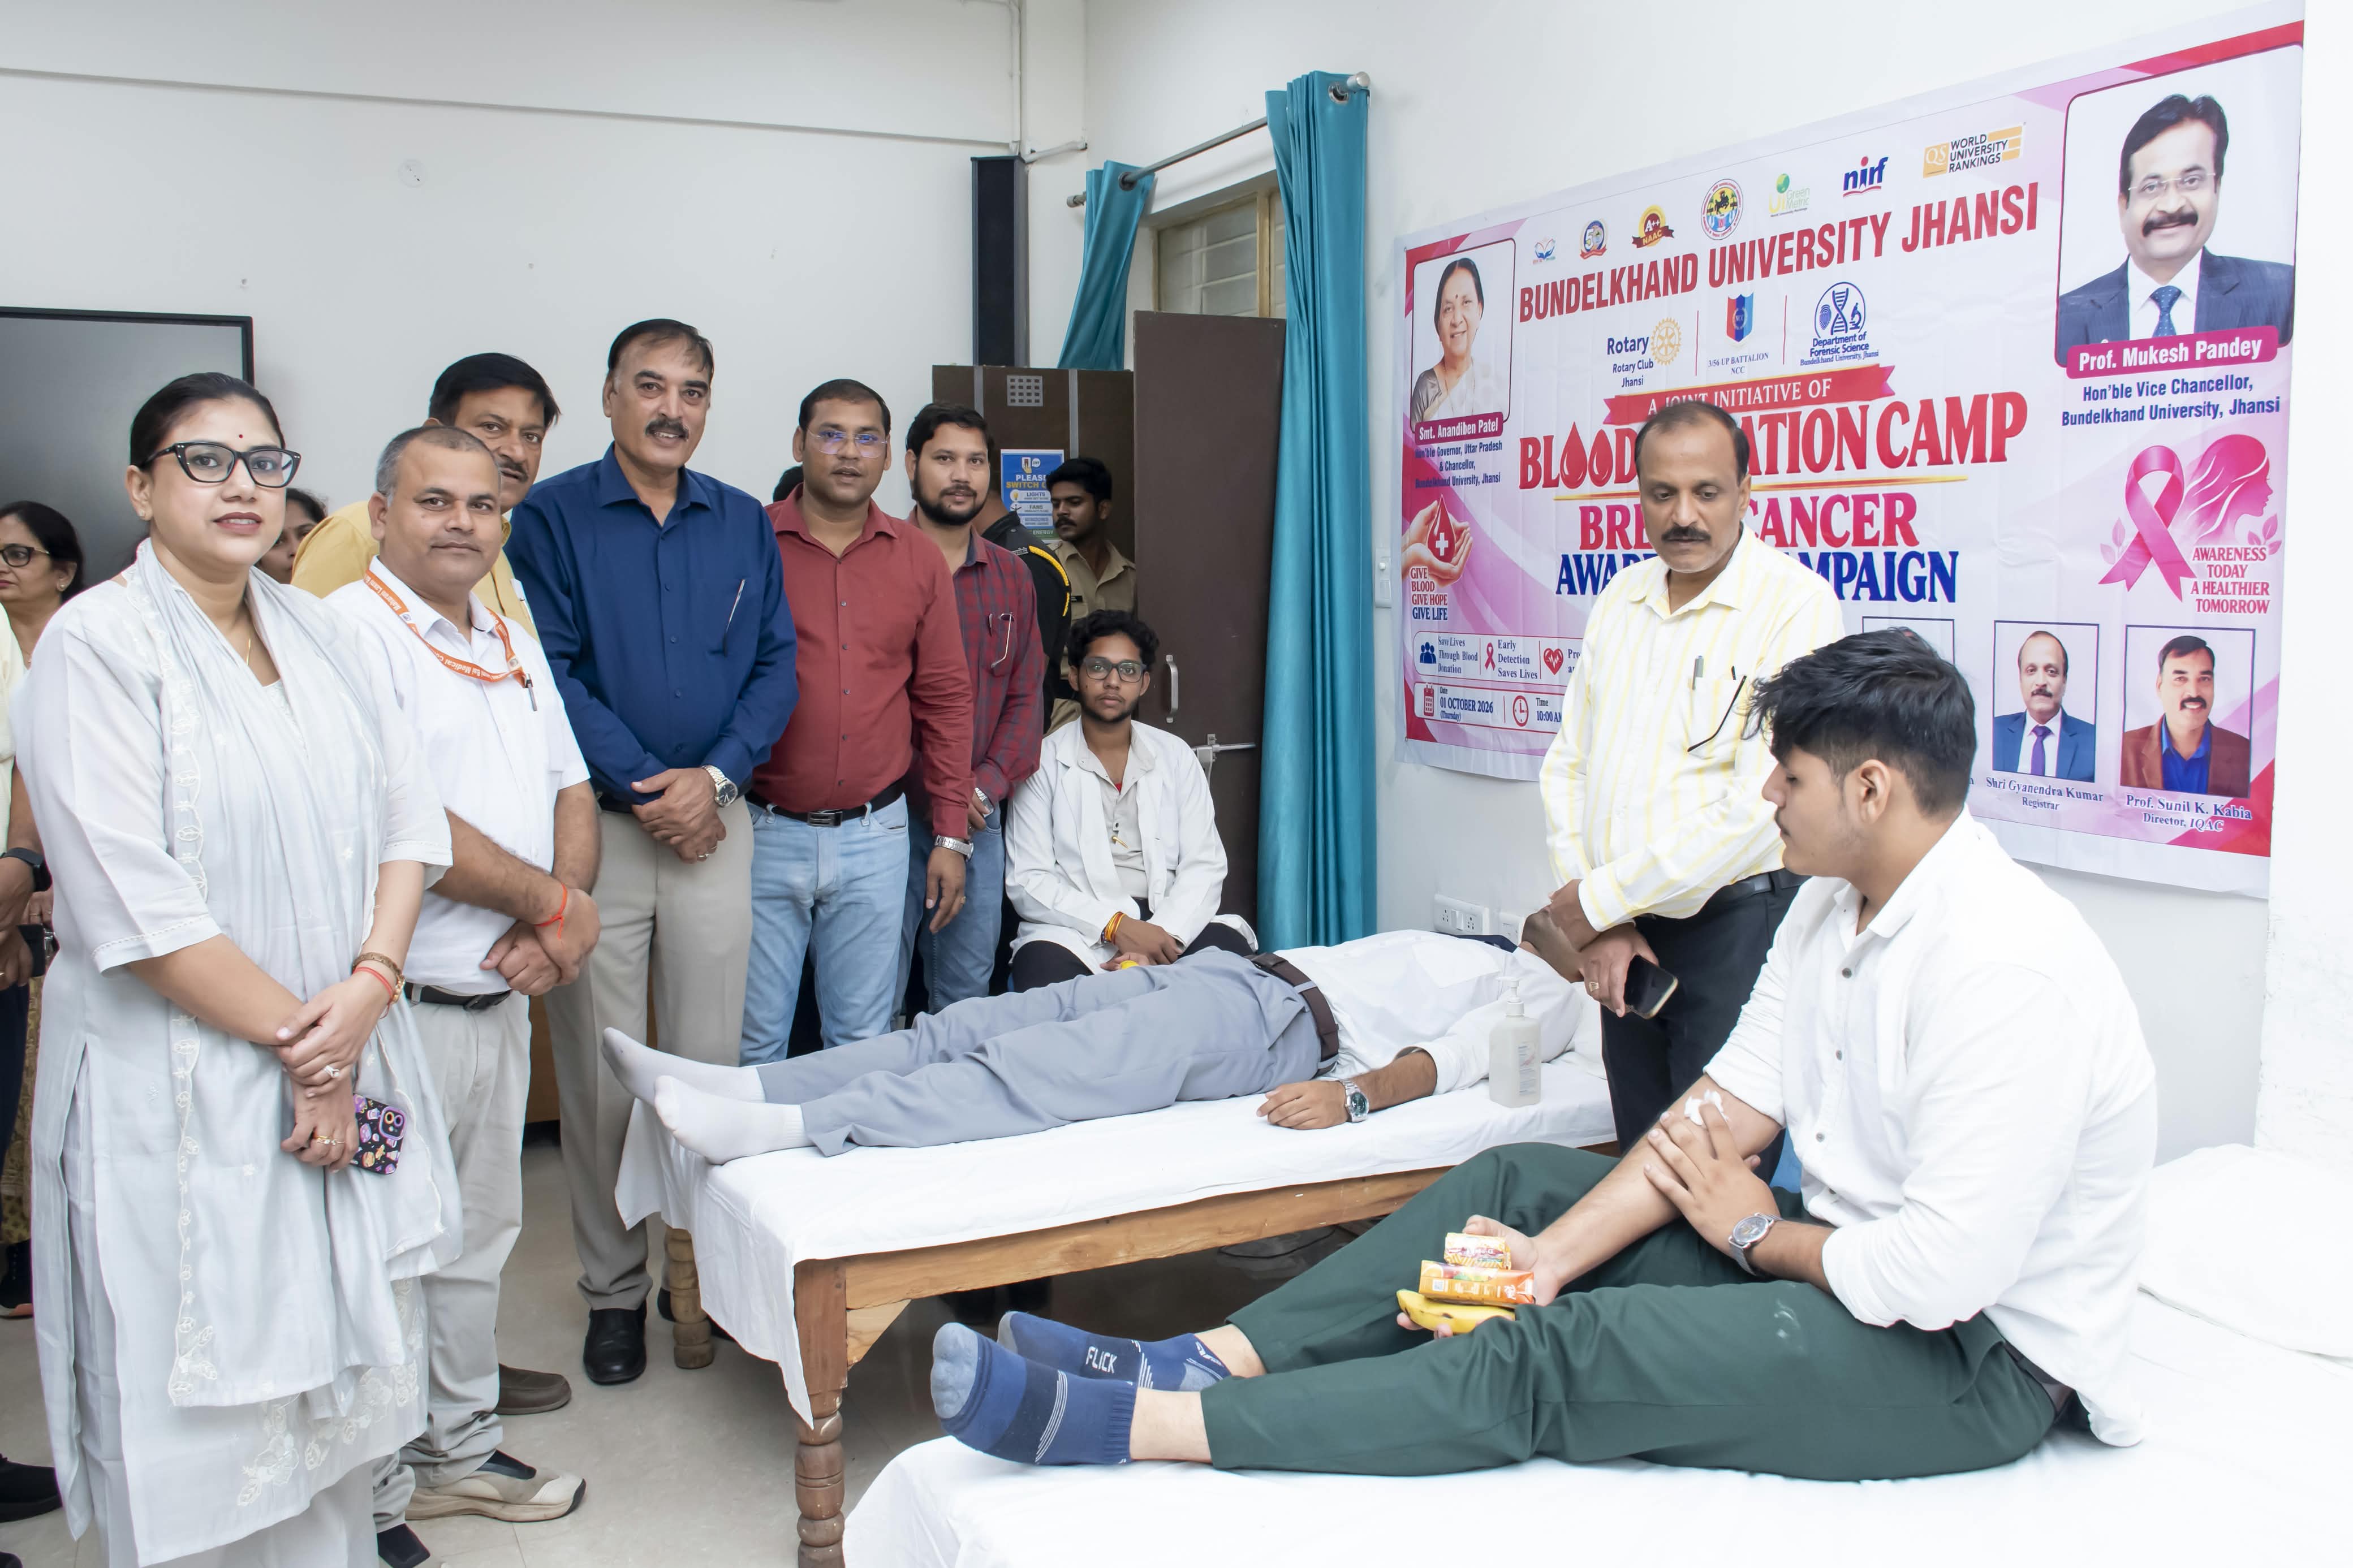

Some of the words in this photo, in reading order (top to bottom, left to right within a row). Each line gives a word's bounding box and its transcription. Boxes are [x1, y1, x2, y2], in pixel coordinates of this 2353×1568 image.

[1951, 134, 1986, 150] WORLD
[1925, 145, 1946, 166] QS
[1950, 140, 2008, 162] UNIVERSITY
[1949, 153, 2001, 172] RANKINGS
[1843, 156, 1889, 191] nirf
[1645, 219, 1660, 232] A++
[1643, 230, 1662, 245] NAAC
[1520, 253, 1697, 323] BUNDELKHAND
[1709, 211, 1891, 288] UNIVERSITY
[1902, 182, 2038, 253] JHANSI
[1607, 336, 1649, 355] Rotary
[1813, 334, 1856, 348] Department
[1858, 331, 1867, 341] of
[1810, 345, 1840, 357] Forensic
[1842, 343, 1869, 353] Science
[1863, 349, 1879, 360] Jhansi
[2079, 352, 2117, 372] Prof.
[2122, 345, 2188, 368] Mukesh
[2195, 338, 2262, 360] Pandey
[1613, 362, 1636, 373] Rotary
[1637, 358, 1653, 370] Club
[1721, 358, 1730, 366] UP
[1731, 353, 1769, 365] BATTALION
[1731, 366, 1746, 375] NCC
[1622, 375, 1644, 387] Jhansi
[2083, 383, 2132, 401] Hon’ble
[2137, 381, 2166, 398] Vice
[2171, 374, 2253, 395] Chancellor,
[1648, 399, 1657, 415] A
[1714, 381, 1802, 408] INITIATIVE
[1808, 378, 1832, 399] OF
[2062, 405, 2144, 426] Bundelkhand
[2149, 401, 2223, 421] University,
[2229, 396, 2281, 416] Jhansi
[1419, 426, 1435, 440] Smt.
[1437, 421, 1475, 438] Anandiben
[1478, 417, 1498, 434] Patel
[1740, 405, 1869, 476] ATION
[1876, 391, 2028, 469] CAMP
[1437, 446, 1462, 457] Governor,
[1464, 443, 1477, 454] Uttar
[1479, 440, 1502, 452] Pradesh
[1440, 461, 1443, 471] &
[1445, 459, 1475, 471] Chancellor,
[1452, 474, 1480, 486] University,
[1482, 472, 1501, 484] Jhansi
[2192, 547, 2267, 561] AWARENESS
[1410, 568, 1428, 579] GIVE
[2207, 564, 2248, 578] TODAY
[1411, 581, 1435, 592] BLOOD
[2190, 582, 2199, 595] A
[2203, 581, 2270, 595] HEALTHIER
[1411, 594, 1428, 605] GIVE
[1429, 594, 1447, 606] HOPE
[2195, 598, 2270, 614] TOMORROW
[1412, 607, 1430, 620] GIVE
[1432, 607, 1448, 620] LIFE
[1438, 636, 1449, 646] Save
[1450, 638, 1465, 647] Lives
[1498, 640, 1516, 651] Early
[1438, 651, 1460, 662] Through
[1462, 651, 1478, 662] Blood
[1498, 654, 1529, 664] Detection
[445, 659, 471, 674] Medical
[1438, 664, 1462, 675] Donation
[1498, 668, 1517, 679] Saves
[1520, 669, 1537, 679] Lives
[1440, 697, 1446, 708] 01
[1448, 697, 1476, 711] OCTOBER
[1477, 700, 1493, 714] 2026
[1536, 697, 1548, 706] Time
[1440, 710, 1461, 722] (Thursday)
[1537, 710, 1553, 722] 10:00
[1986, 777, 2005, 789] Shri
[2009, 780, 2062, 797] Gyanendra
[2066, 787, 2104, 802] Kumar
[2022, 797, 2060, 810] Registrar
[2126, 794, 2154, 809] Prof.
[2157, 798, 2190, 812] Sunil
[2195, 802, 2208, 814] K.
[2213, 804, 2251, 819] Kabia
[2143, 813, 2186, 827] Director,
[2190, 818, 2223, 831] IQAC
[1085, 1346, 1118, 1374] FLICK
